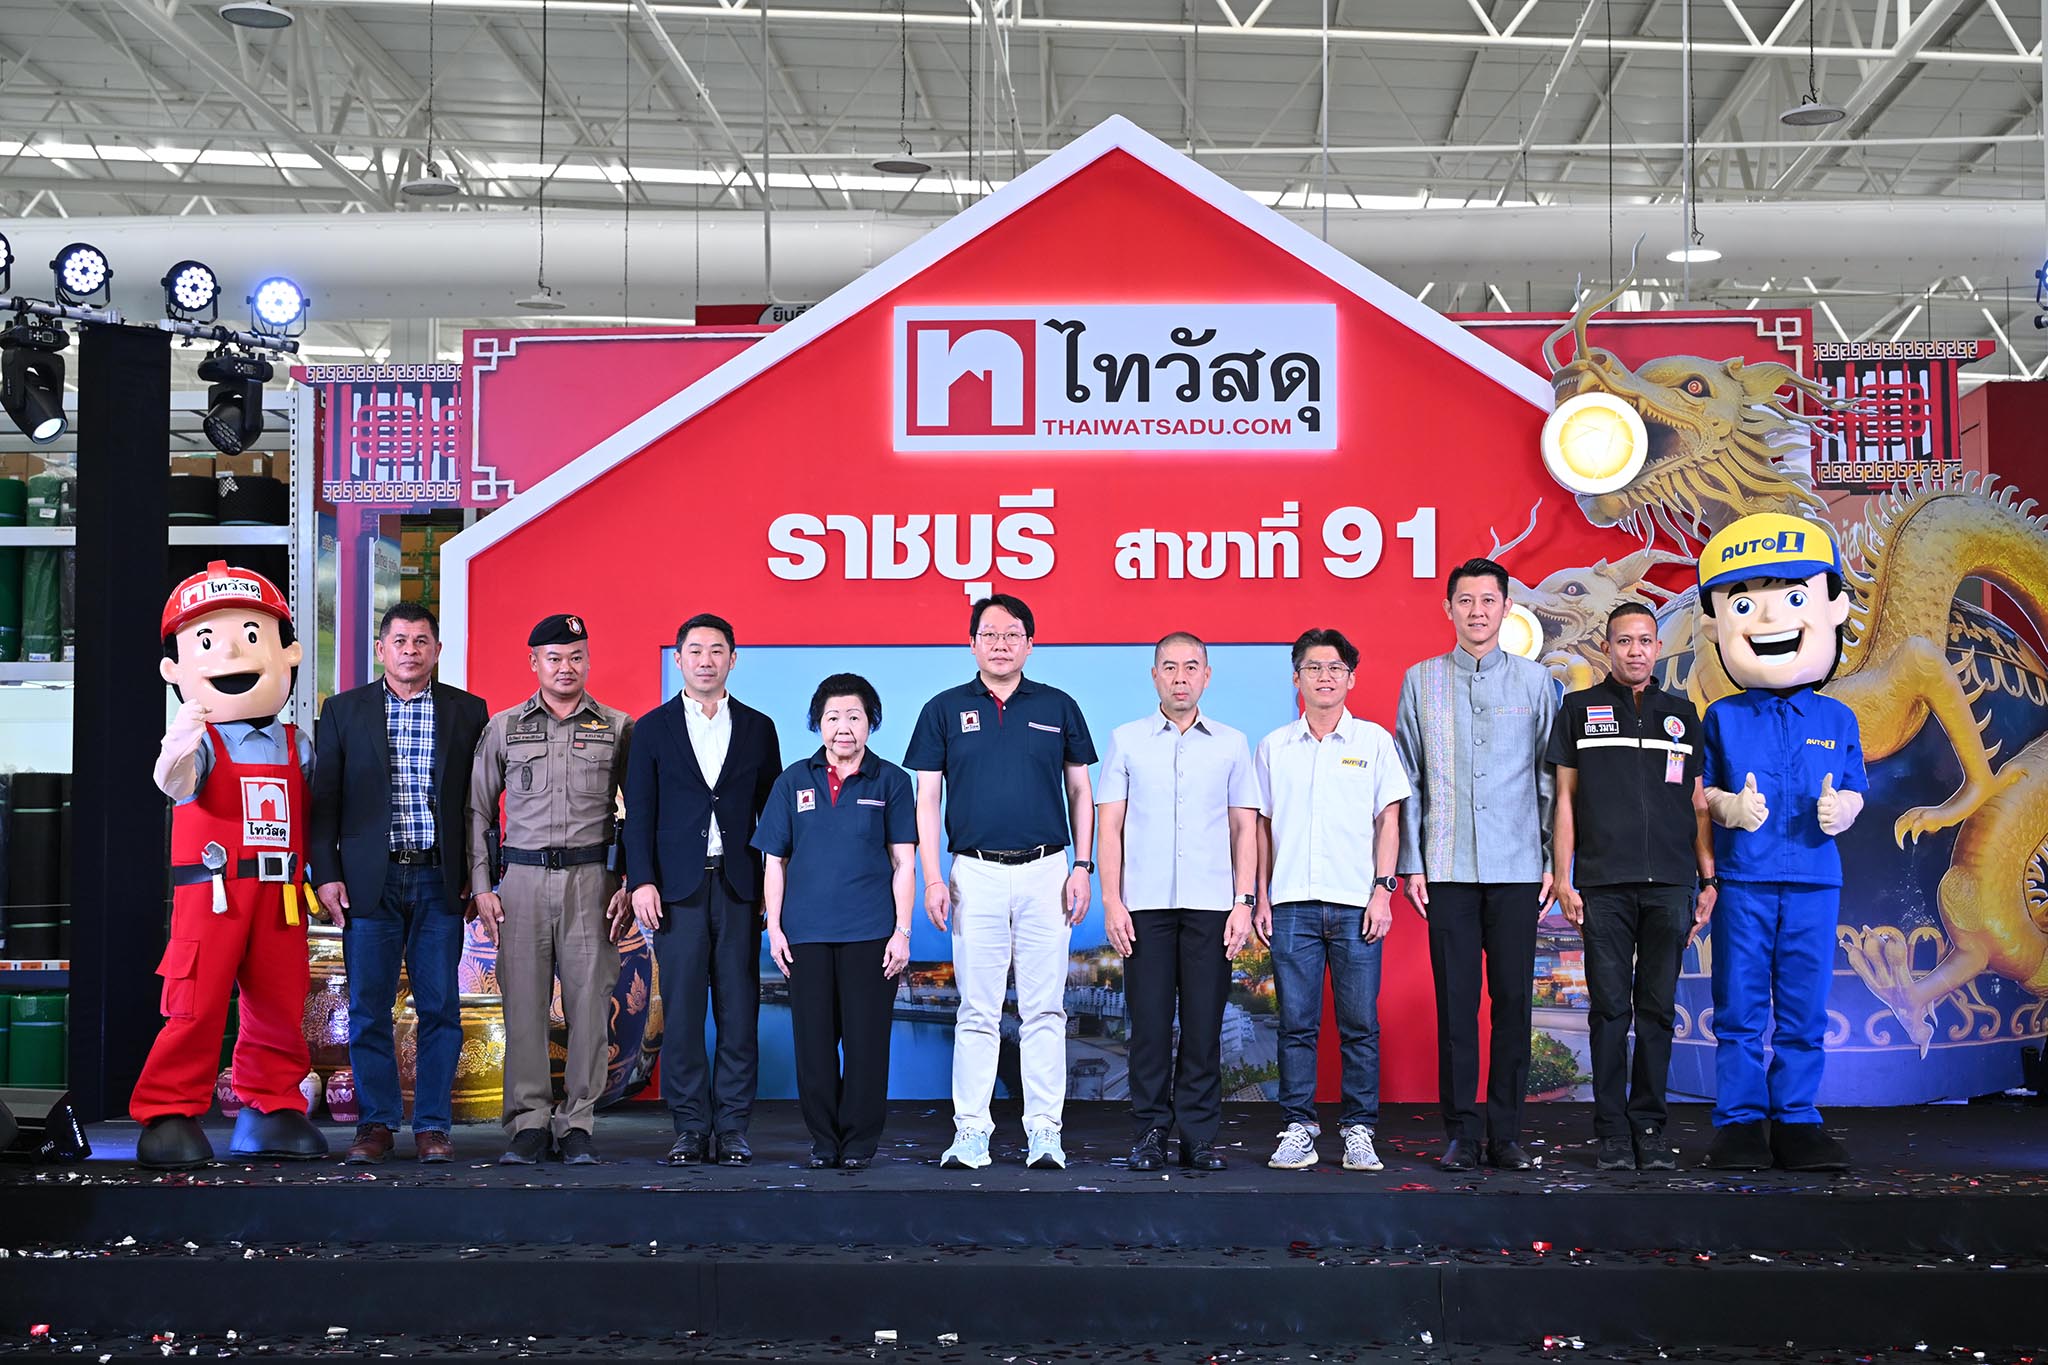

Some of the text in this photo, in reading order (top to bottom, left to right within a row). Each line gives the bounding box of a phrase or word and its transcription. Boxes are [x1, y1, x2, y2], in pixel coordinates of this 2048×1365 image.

[1043, 318, 1321, 432] ไทวัสดุ
[1042, 418, 1292, 436] THAIWATSADU.COM
[767, 488, 1437, 606] ราชบุรี สาขาที่ 91
[1721, 531, 1805, 563] AUTO1
[207, 579, 261, 599] ไทวัสดุ
[247, 822, 287, 842] ไทวัสดุ
